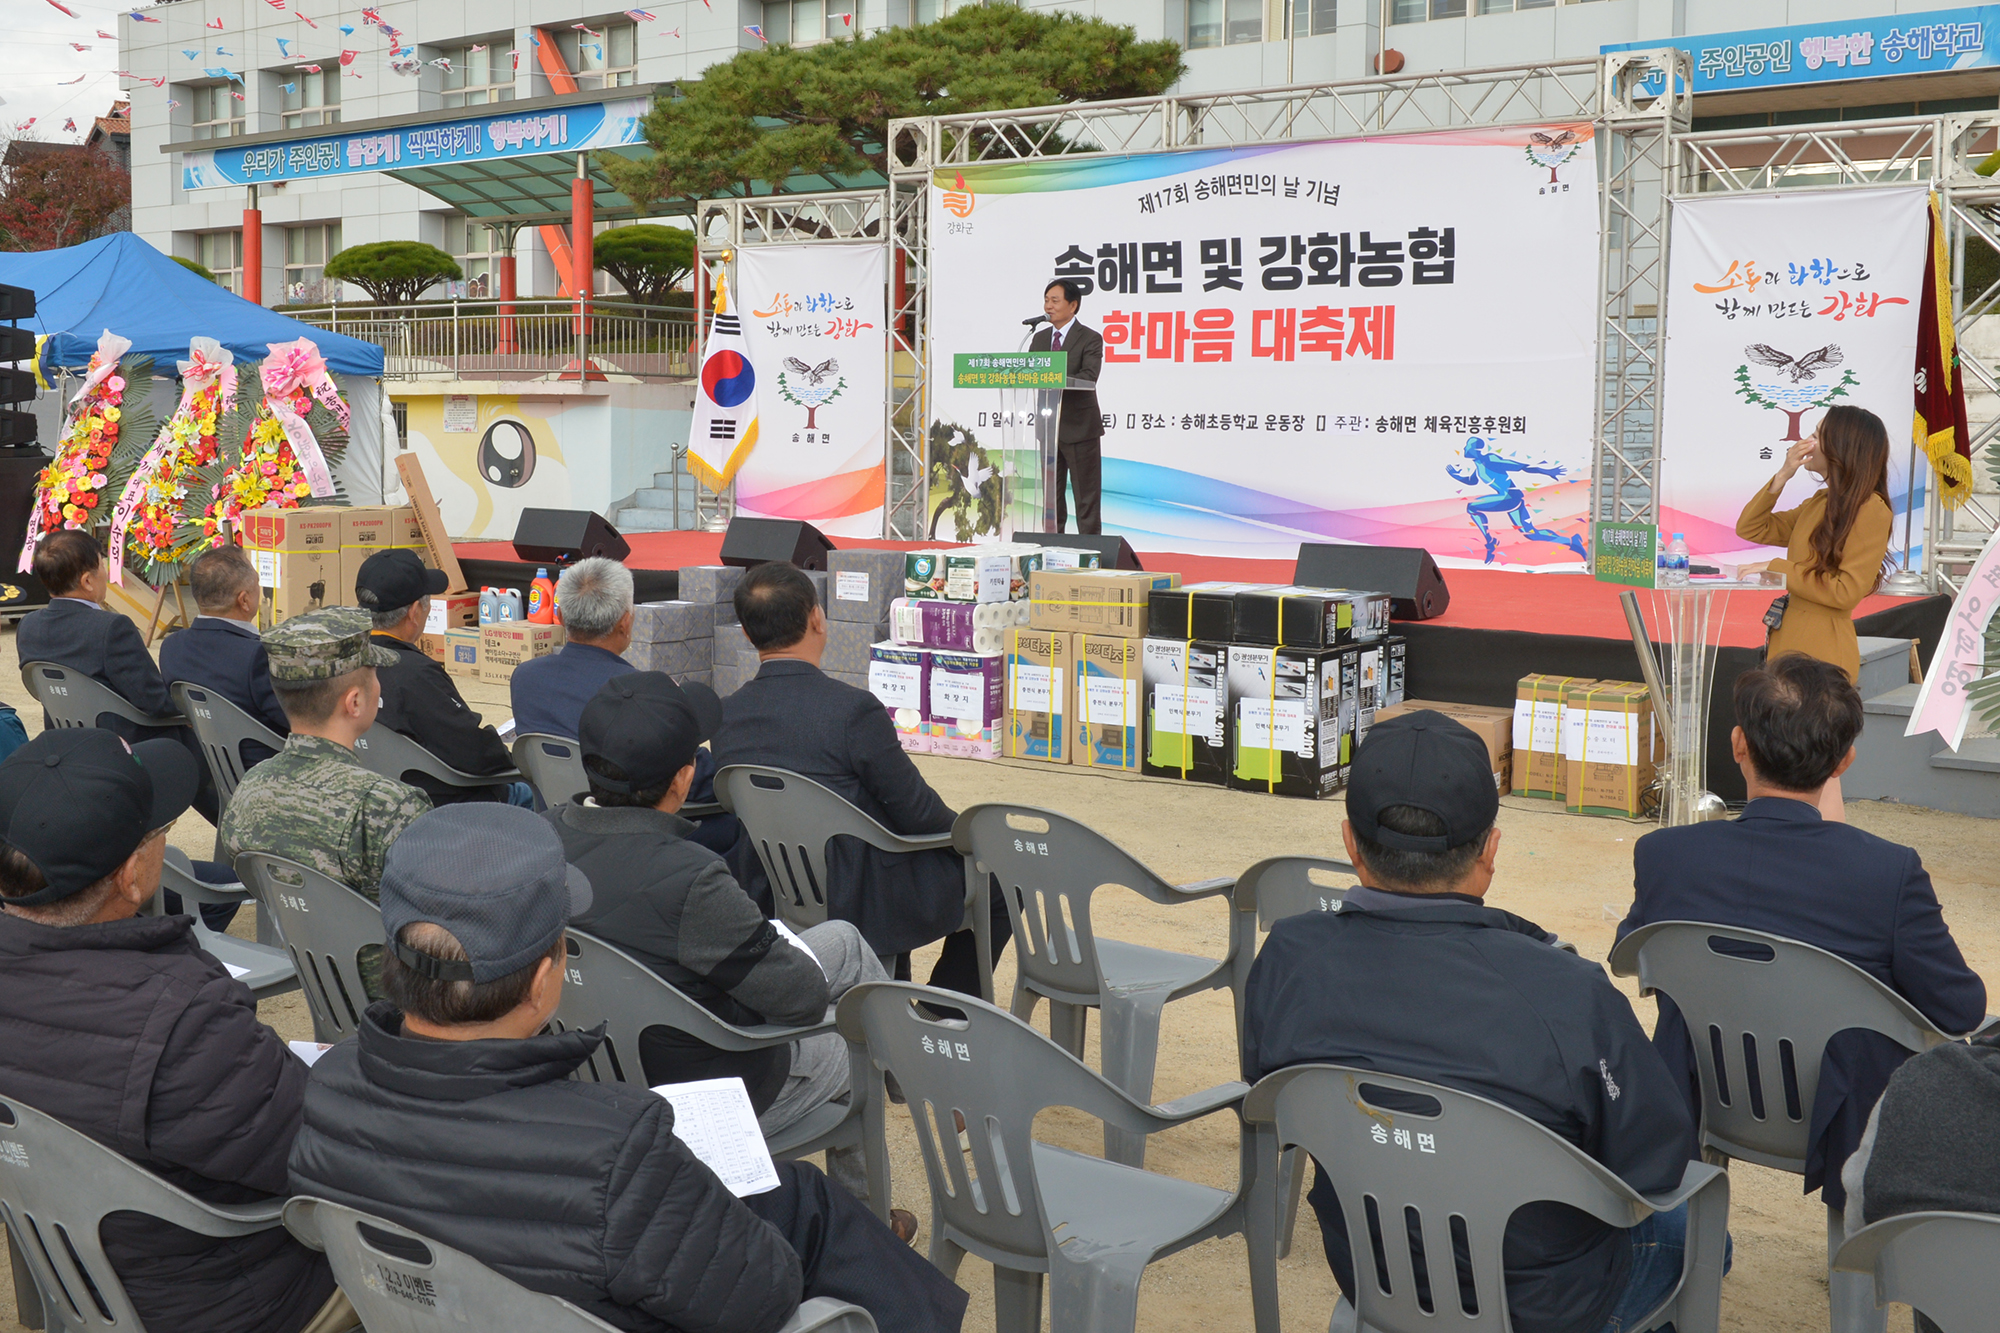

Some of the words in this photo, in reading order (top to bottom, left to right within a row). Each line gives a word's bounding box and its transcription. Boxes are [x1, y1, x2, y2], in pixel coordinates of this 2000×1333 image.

[1699, 40, 1791, 79] 주인공인
[1800, 32, 1874, 70] 행복한
[1881, 22, 1984, 62] 송해학교
[241, 147, 285, 178] 우리가
[288, 141, 340, 173] 주인공!
[346, 134, 401, 167] 즐겁게!
[407, 125, 481, 160] 씩씩하게!
[488, 114, 568, 151] 행복하게!
[1138, 181, 1189, 216] 제17회
[1194, 173, 1276, 203] 송해면민의
[1283, 176, 1300, 200] 날
[1306, 179, 1341, 207] 기념
[947, 222, 974, 235] 강화군
[1053, 240, 1182, 296] 송해면
[1200, 237, 1244, 293] 및
[1259, 226, 1455, 292] 강화농협
[1693, 259, 1780, 293] 소통과
[1788, 258, 1870, 286] 화합으로
[752, 292, 803, 318] 소통과
[806, 292, 854, 313] 화합으로
[1715, 298, 1761, 320] 함께
[1768, 301, 1812, 319] 만드는
[1817, 290, 1910, 321] 강화
[766, 321, 793, 338] 함께
[796, 323, 821, 337] 만드는
[824, 316, 874, 340] 강화
[1102, 307, 1235, 363] 한마음
[1251, 305, 1395, 361] 대축제
[968, 358, 990, 369] 제17회
[992, 357, 1026, 368] 송해면민의
[1027, 357, 1035, 368] 날
[1036, 356, 1051, 368] 기념
[957, 373, 979, 385] 송해면
[979, 373, 987, 385] 및
[988, 373, 1016, 385] 강화농협
[1017, 372, 1039, 385] 한마음
[1040, 371, 1062, 385] 대축제
[1141, 413, 1165, 430] 장소
[1180, 414, 1258, 431] 송해초등학교
[1264, 414, 1305, 432] 운동장
[1375, 415, 1417, 433] 송해면
[1424, 415, 1527, 434] 체육진흥후원회
[534, 632, 543, 640] LG
[882, 683, 906, 692] 화장지
[943, 693, 969, 703] 화장지
[1014, 839, 1049, 856] 송해면
[280, 893, 309, 912] 송해면
[921, 1035, 971, 1062] 송해면
[1370, 1123, 1436, 1154] 송해면
[402, 1274, 437, 1298] 이벤트
